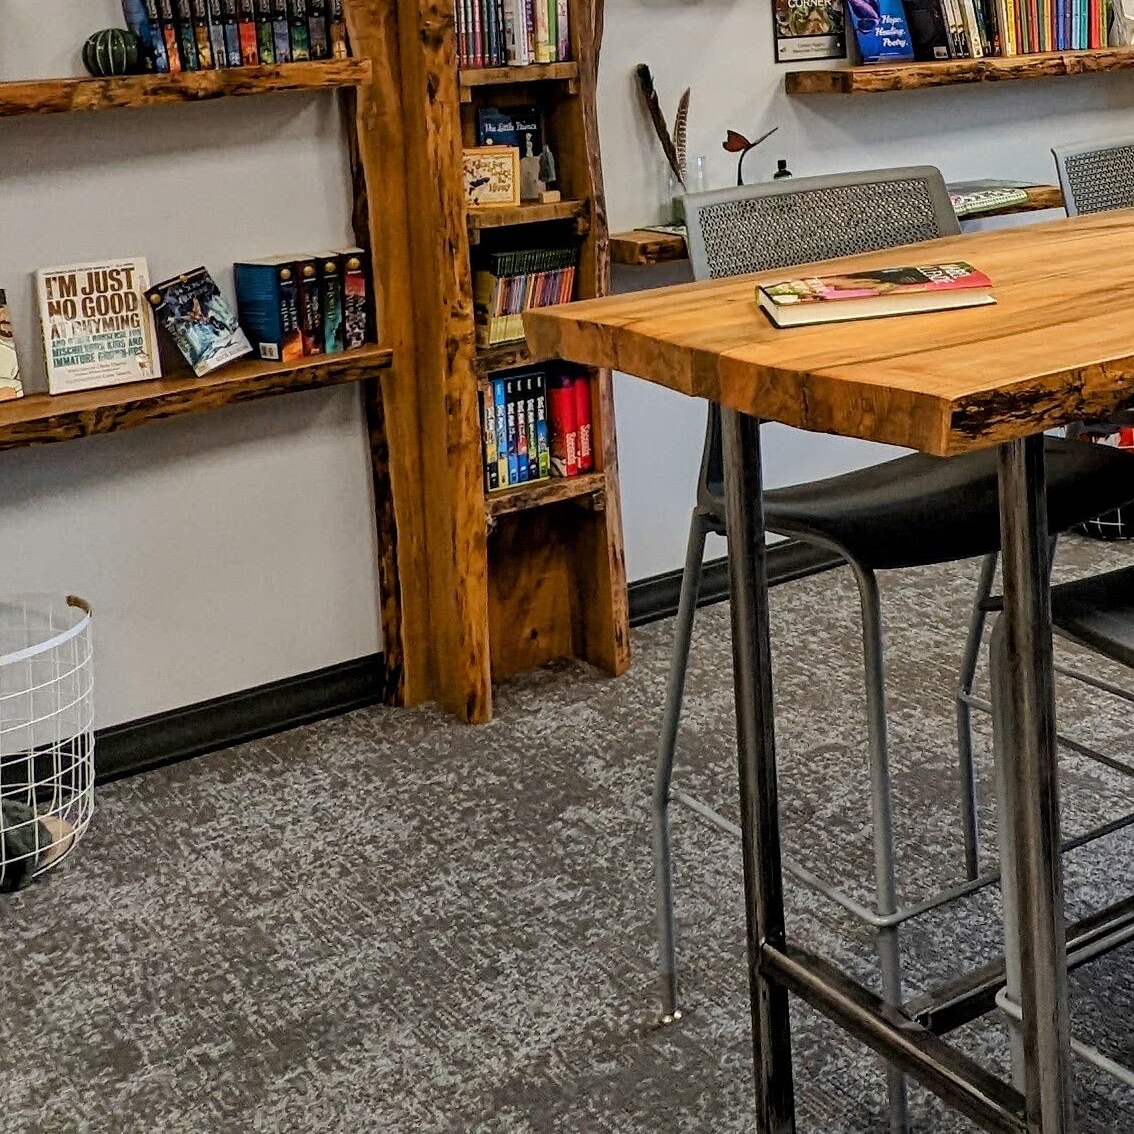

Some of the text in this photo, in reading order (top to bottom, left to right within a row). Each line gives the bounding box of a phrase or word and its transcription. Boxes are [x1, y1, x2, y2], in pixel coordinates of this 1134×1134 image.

[882, 38, 908, 48] Poetry.
[484, 120, 537, 132] The Little Prince
[45, 274, 78, 300] I'M
[81, 267, 135, 296] JUST
[47, 291, 138, 322] NO GOOD
[51, 313, 140, 340] AT RHYMING
[108, 339, 126, 350] KIDS
[128, 336, 144, 346] AND
[53, 353, 96, 368] IMMATURE
